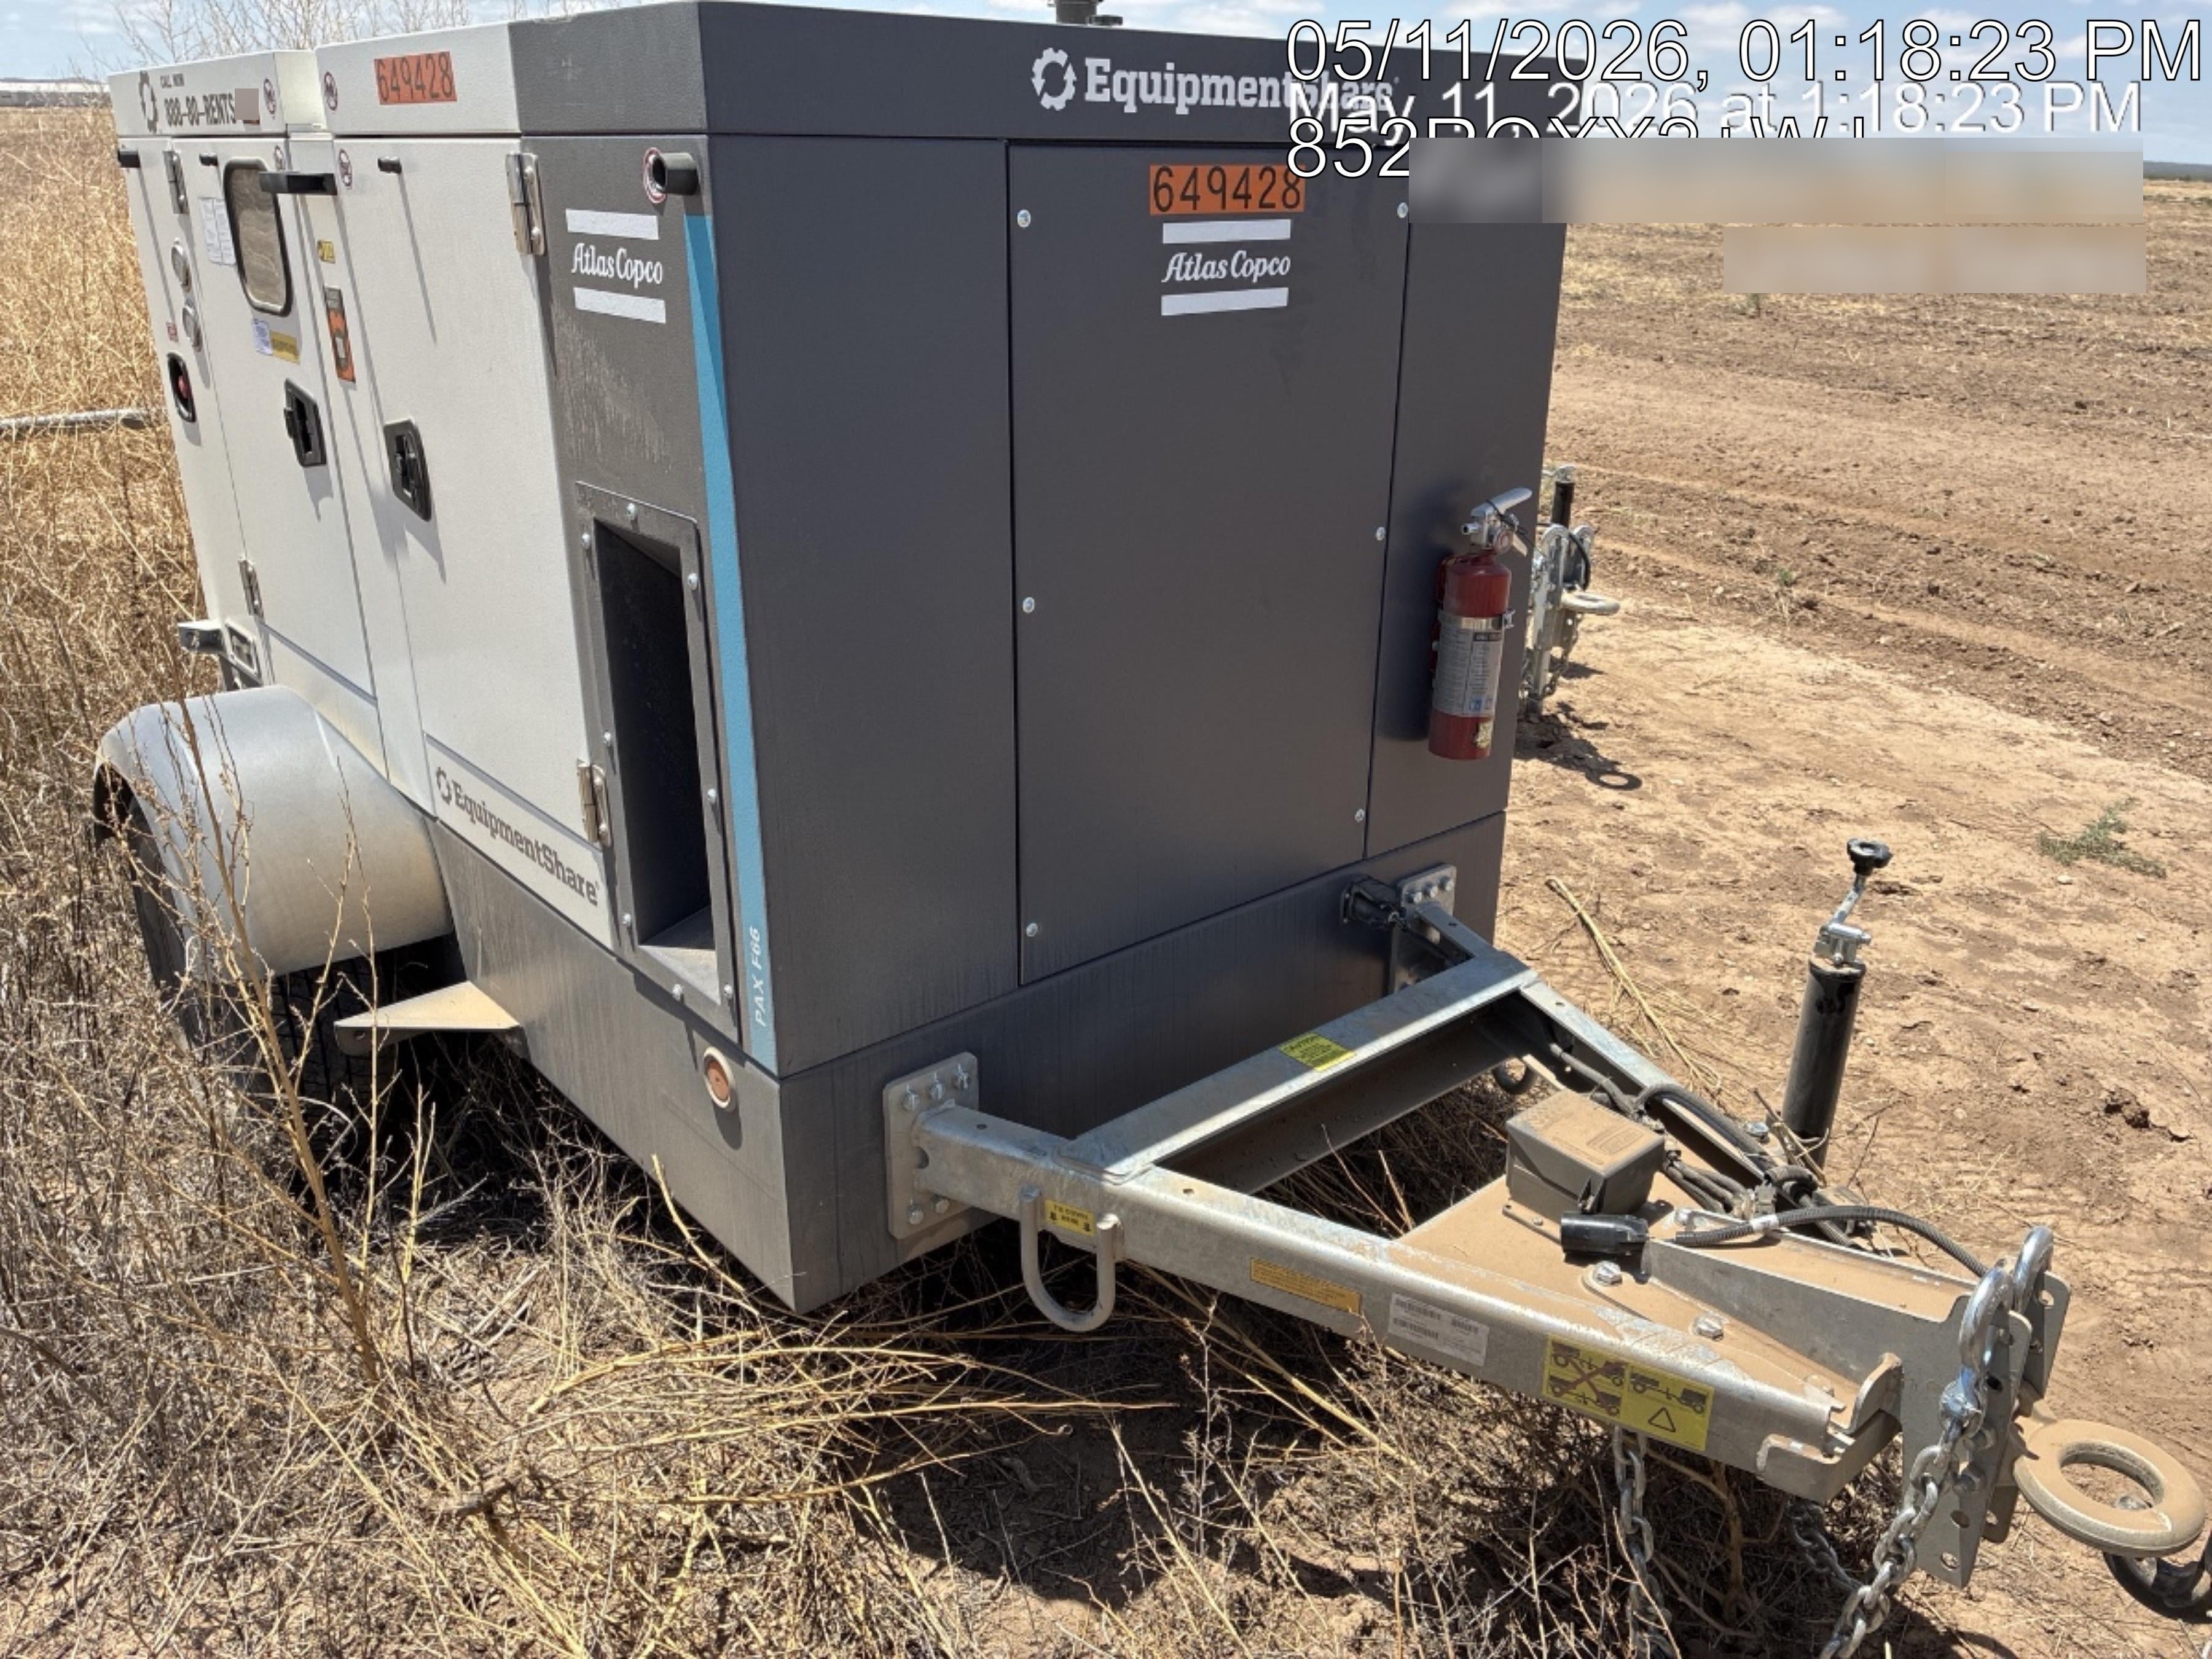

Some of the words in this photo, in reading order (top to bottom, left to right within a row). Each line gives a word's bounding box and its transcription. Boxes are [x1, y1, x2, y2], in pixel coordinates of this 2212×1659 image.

[377, 52, 453, 103] 649428
[1153, 166, 1301, 213] 649428
[452, 779, 598, 907] EquipmentShare
[752, 973, 766, 1027] PAX
